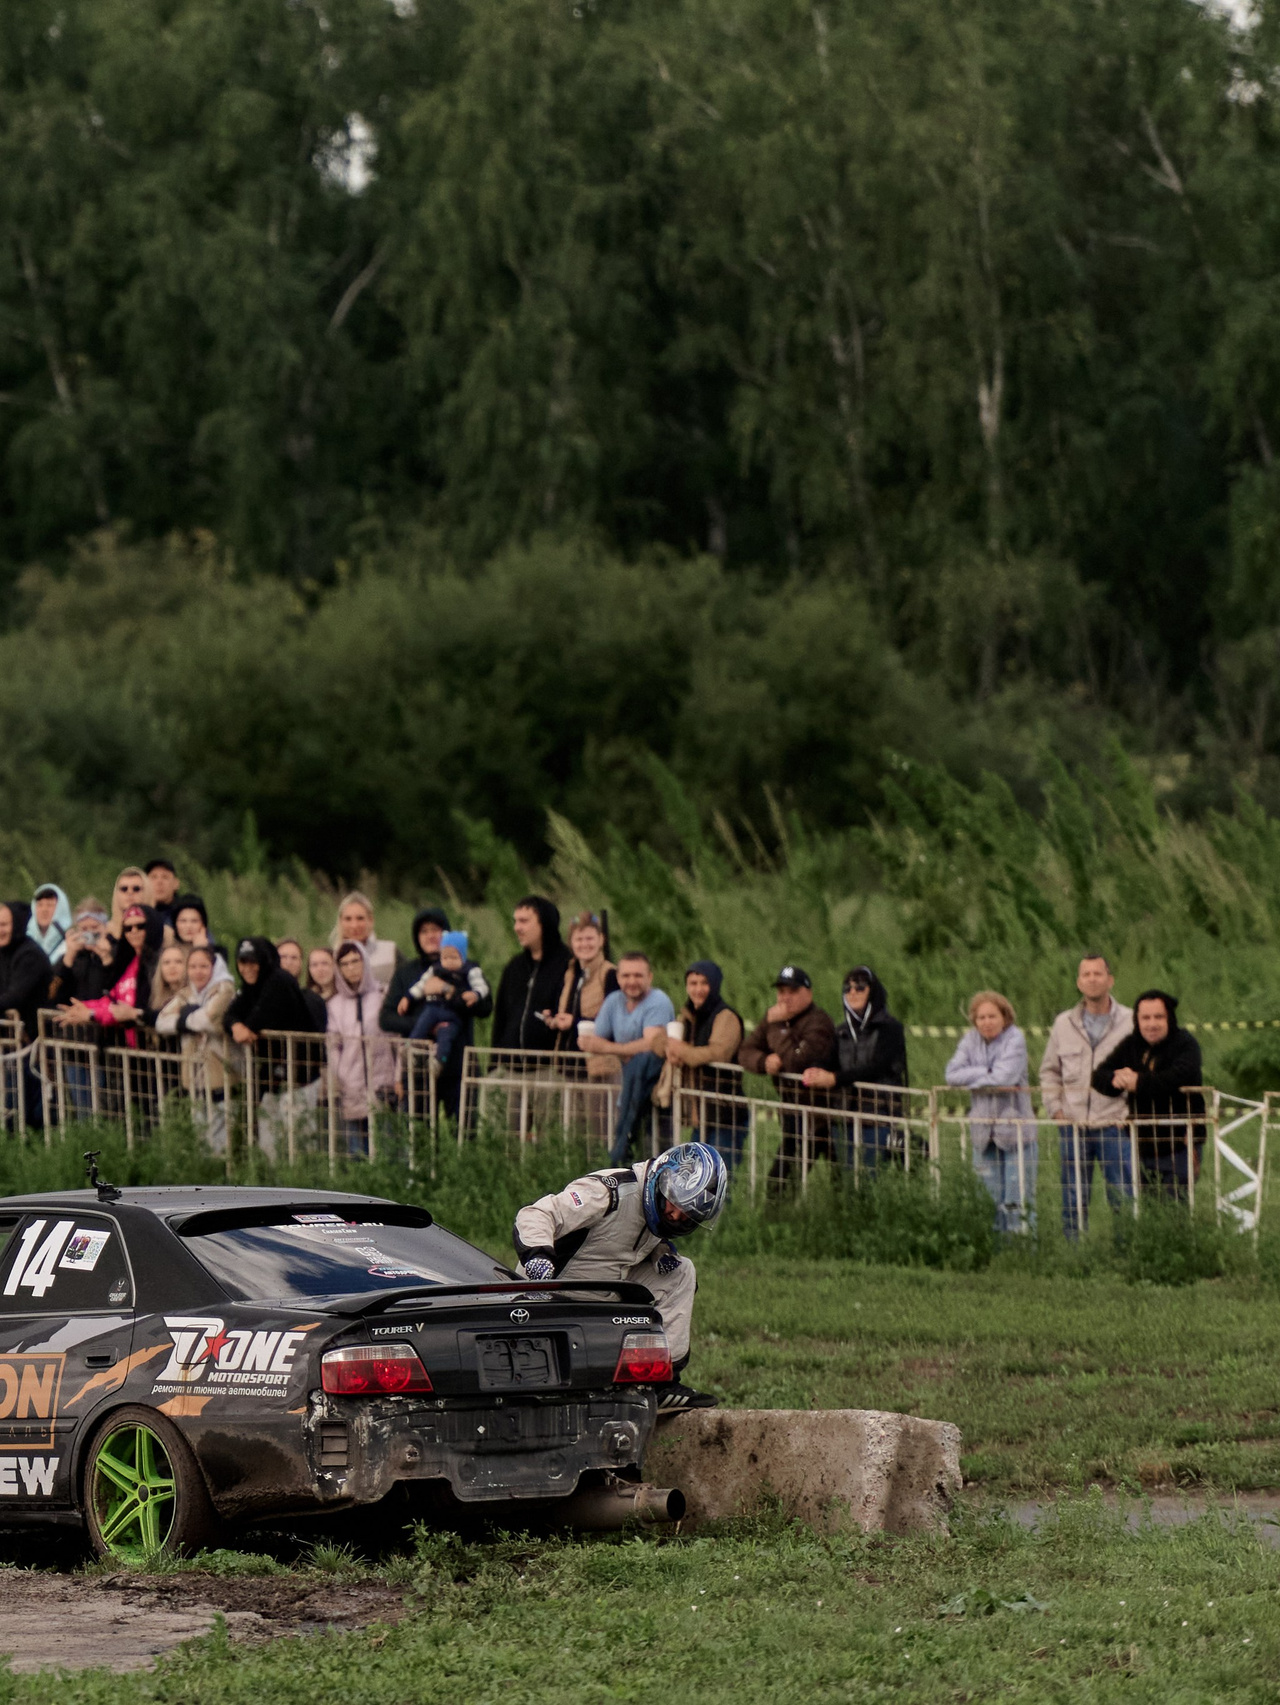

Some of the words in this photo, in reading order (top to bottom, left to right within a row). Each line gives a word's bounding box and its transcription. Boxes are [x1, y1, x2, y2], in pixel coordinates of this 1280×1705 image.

[3, 1219, 76, 1297] 14
[612, 1316, 651, 1325] CHASER
[372, 1325, 413, 1336] TOURER
[415, 1322, 425, 1333] V
[207, 1371, 292, 1385] MOTORSPORT
[151, 1384, 186, 1395] ремонт
[193, 1386, 227, 1395] тюнинг
[228, 1386, 288, 1398] автомобилей
